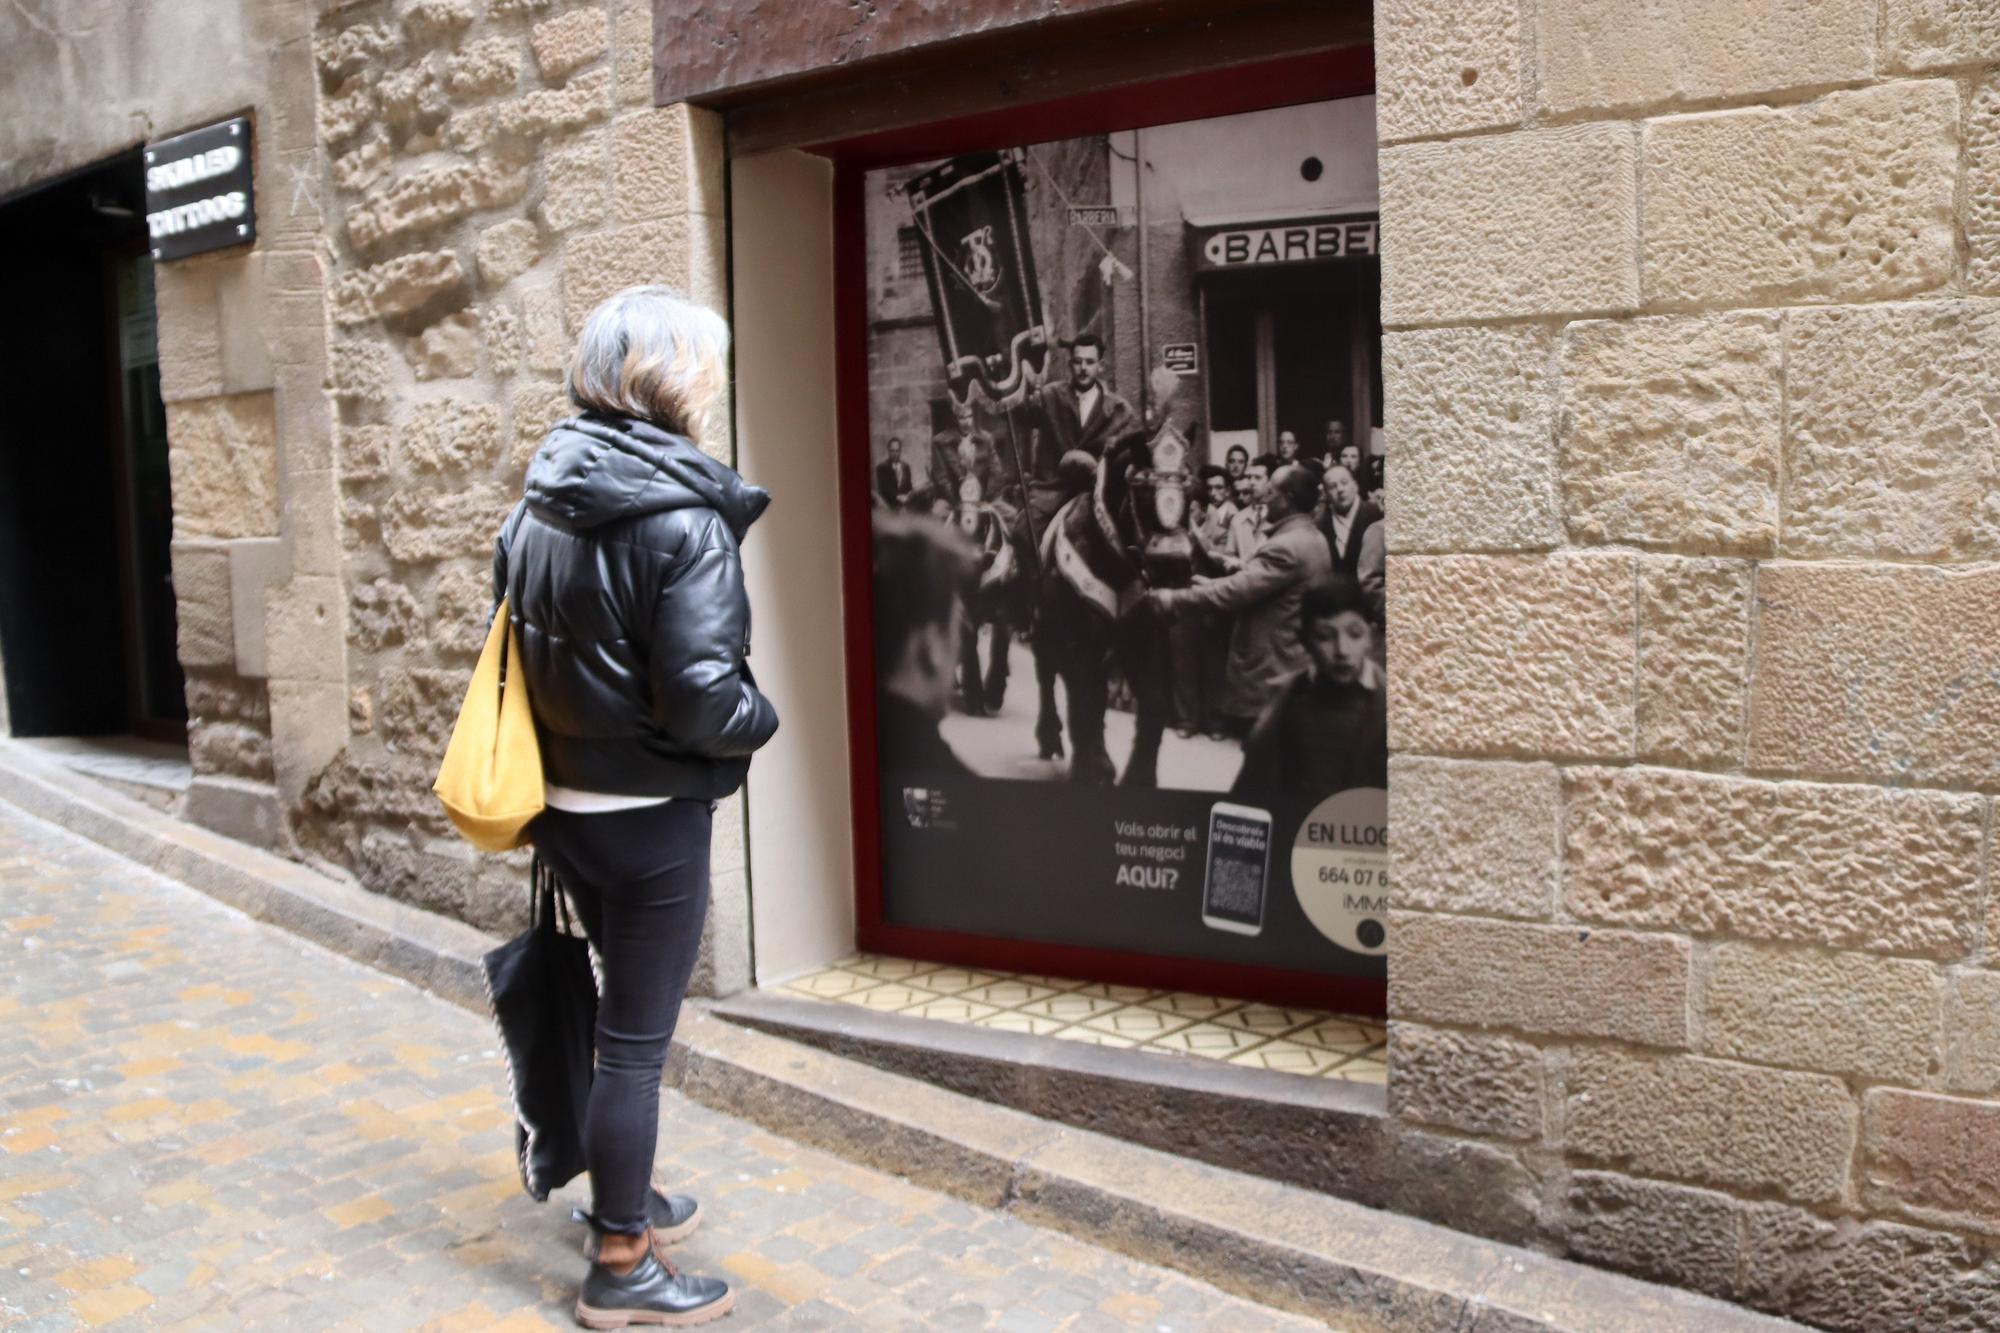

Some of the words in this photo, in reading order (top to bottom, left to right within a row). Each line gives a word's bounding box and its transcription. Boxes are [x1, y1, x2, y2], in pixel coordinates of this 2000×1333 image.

[146, 192, 246, 238] TATTOOS
[1225, 223, 1381, 264] BARBE
[1114, 820, 1145, 838] Vols
[1147, 823, 1180, 840] obrir
[1183, 827, 1197, 841] el
[1308, 822, 1335, 843] EN
[1115, 842, 1136, 857] teu
[1140, 845, 1185, 862] negoci
[1318, 866, 1349, 884] 664
[1353, 869, 1373, 886] 07
